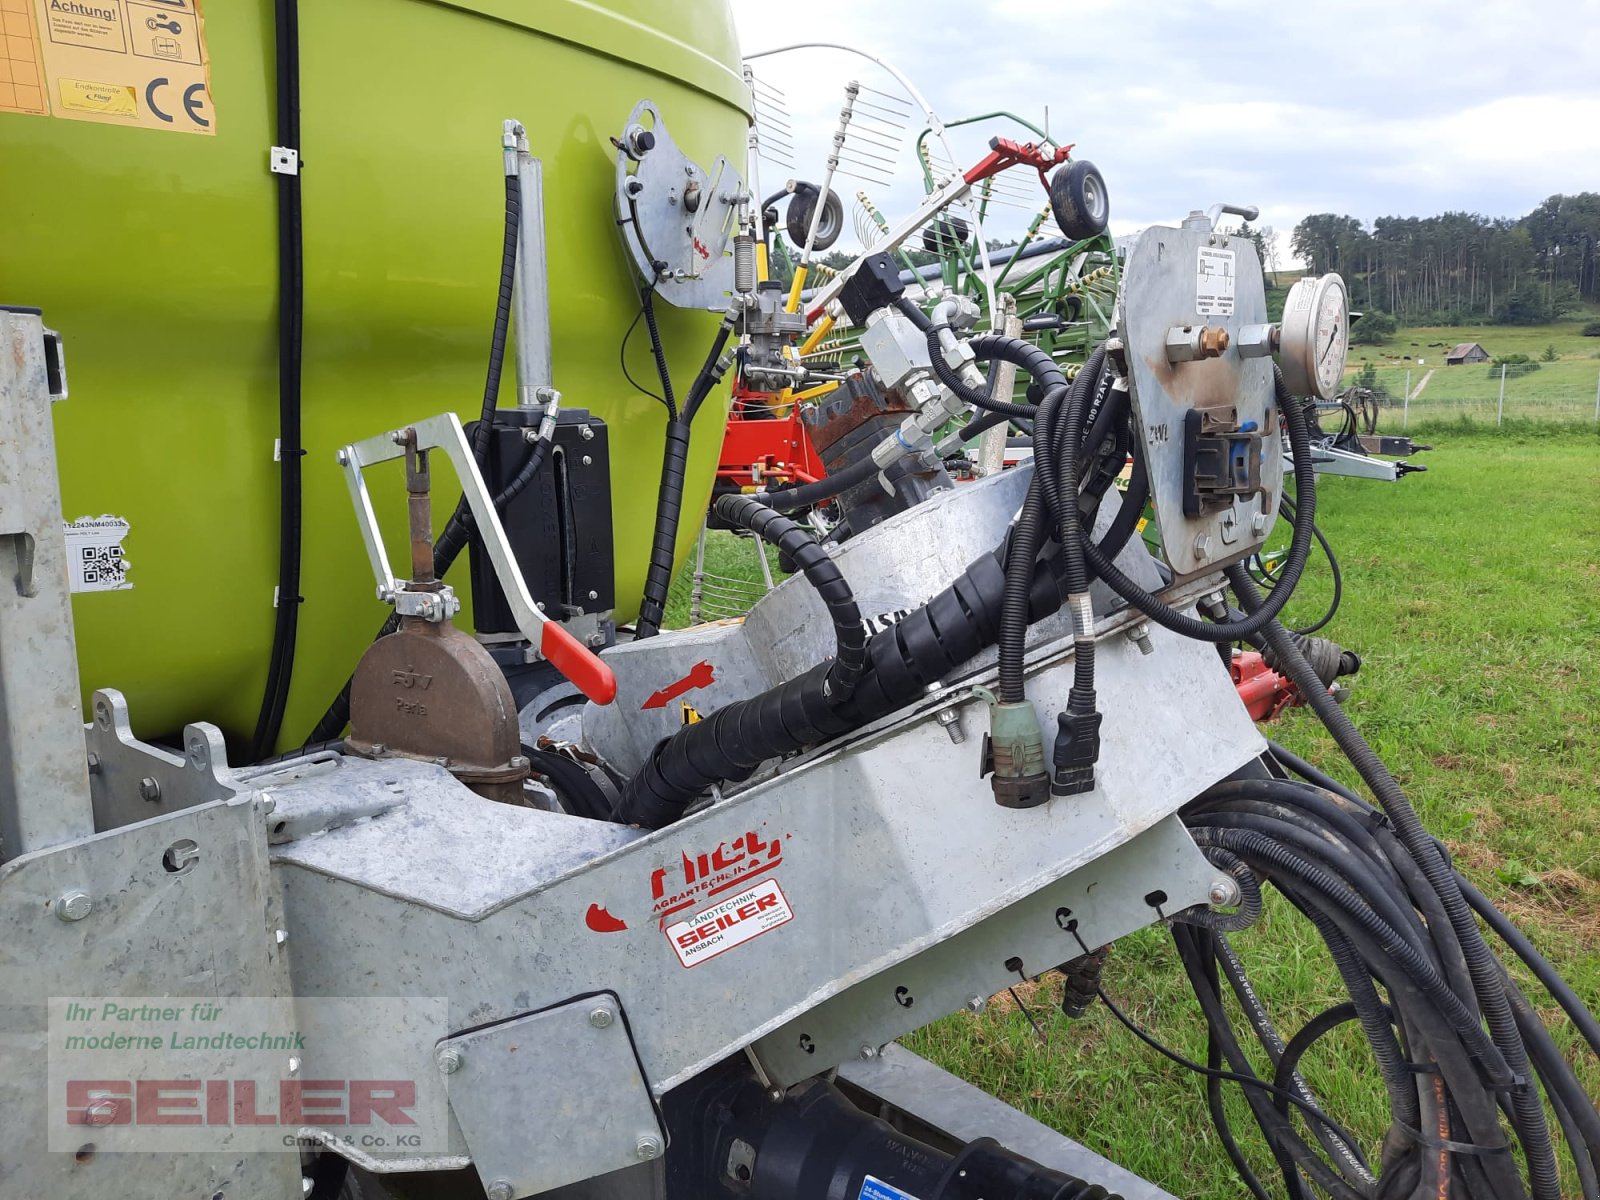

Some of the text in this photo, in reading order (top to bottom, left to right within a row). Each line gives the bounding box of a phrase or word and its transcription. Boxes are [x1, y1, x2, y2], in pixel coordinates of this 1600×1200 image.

[51, 0, 117, 21] Achtung!
[75, 82, 121, 94] Endkontrolle
[1086, 408, 1098, 425] 100
[1093, 378, 1109, 407] R2AT
[676, 892, 779, 949] SEILER
[688, 891, 758, 928] LANDTECHNIK
[684, 934, 724, 957] ANSBACH
